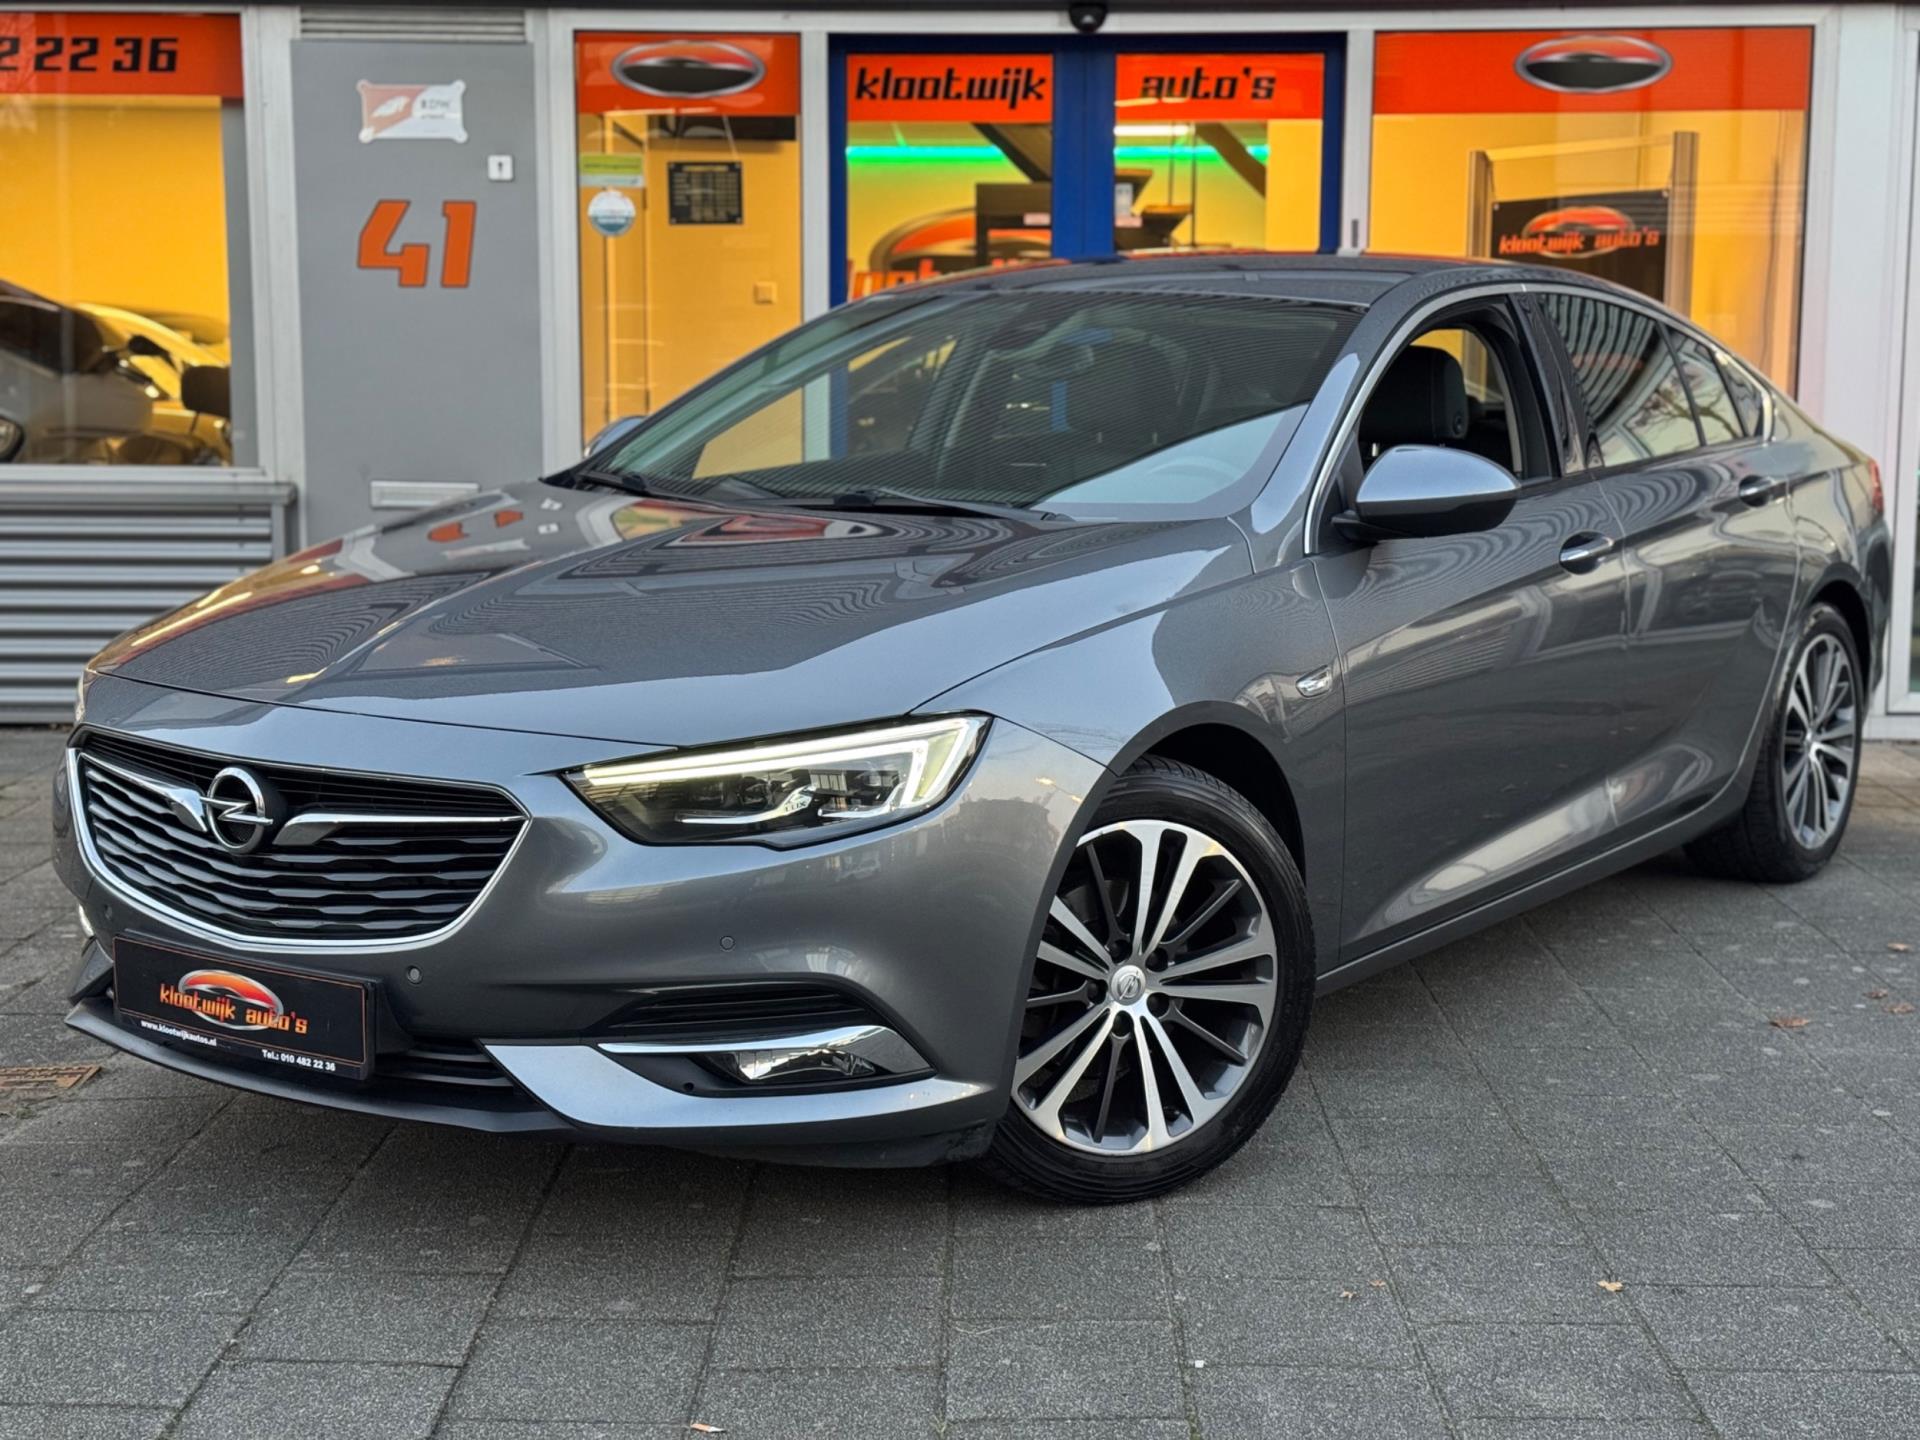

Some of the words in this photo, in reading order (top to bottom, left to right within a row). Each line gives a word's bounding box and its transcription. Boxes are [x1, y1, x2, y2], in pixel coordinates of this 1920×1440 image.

[34, 36, 99, 71] 22
[112, 36, 178, 72] 36
[855, 66, 1046, 110] klootwijk
[1141, 66, 1276, 100] auto's
[357, 200, 476, 288] 41
[1499, 230, 1584, 256] klootwijk
[160, 983, 236, 1023] klootwijk
[245, 1007, 308, 1034] auto's
[281, 1053, 295, 1063] 010
[296, 1056, 312, 1067] 482
[313, 1059, 324, 1069] 22
[325, 1061, 336, 1071] 36
